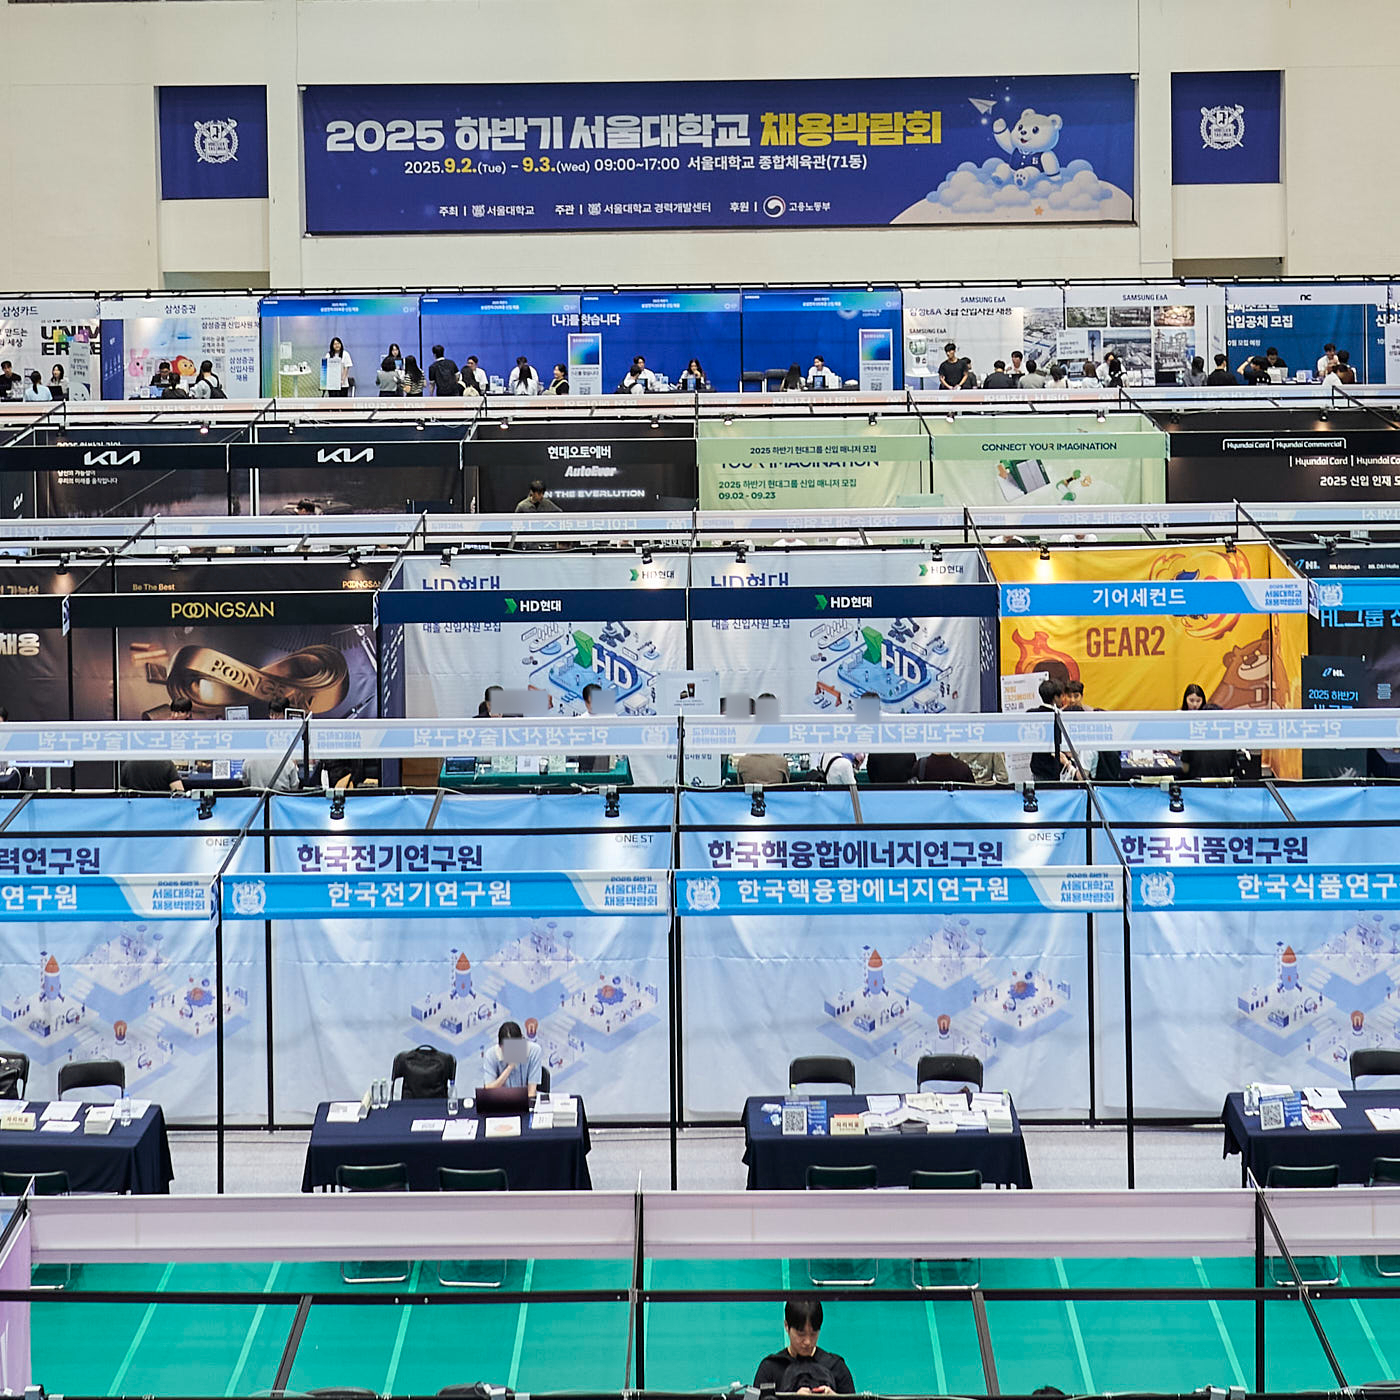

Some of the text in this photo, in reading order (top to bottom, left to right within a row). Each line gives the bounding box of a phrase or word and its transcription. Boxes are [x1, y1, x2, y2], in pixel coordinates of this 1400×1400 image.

[326, 111, 941, 151] 2025 하반기 서울대학교 채용박람회
[404, 155, 867, 175] 2025.9.2.(Tue) 9.3.(Wed) 09:00~17:00 서울대학교 종합체육관(71동)
[439, 204, 535, 216] 주최 서울대학교
[555, 202, 711, 216] 주관 서울대학교 경력개발센터
[729, 201, 830, 213] 후원 고용노동부
[2, 306, 38, 316] 삼성카드
[164, 304, 196, 314] 삼성증권
[1056, 442, 1116, 450] IMAGINATION
[1227, 441, 1252, 449] Hyundai
[1276, 440, 1342, 449] Hyundai Commercial
[547, 445, 612, 459] 현대오토에버
[743, 480, 765, 489] 하반기
[800, 479, 815, 488] 신입
[842, 478, 856, 488] 모집
[1320, 476, 1347, 486] 2025
[1350, 476, 1369, 487] 신입
[1372, 476, 1391, 486] 인재
[719, 492, 743, 500] 09.02
[1092, 588, 1186, 606] 기어세컨드
[172, 601, 274, 619] POONGSAN
[520, 599, 562, 613] HD현대
[1086, 626, 1165, 657] GEAR2
[297, 841, 484, 872] 한국전기연구원
[707, 839, 1004, 870] 한국핵융합에너지연구원
[1121, 834, 1309, 865] 한국식품연구원
[327, 879, 512, 908] 한국전기연구원
[604, 881, 658, 895] 서울대학교
[737, 874, 1009, 904] 한국핵융합에너지연구원
